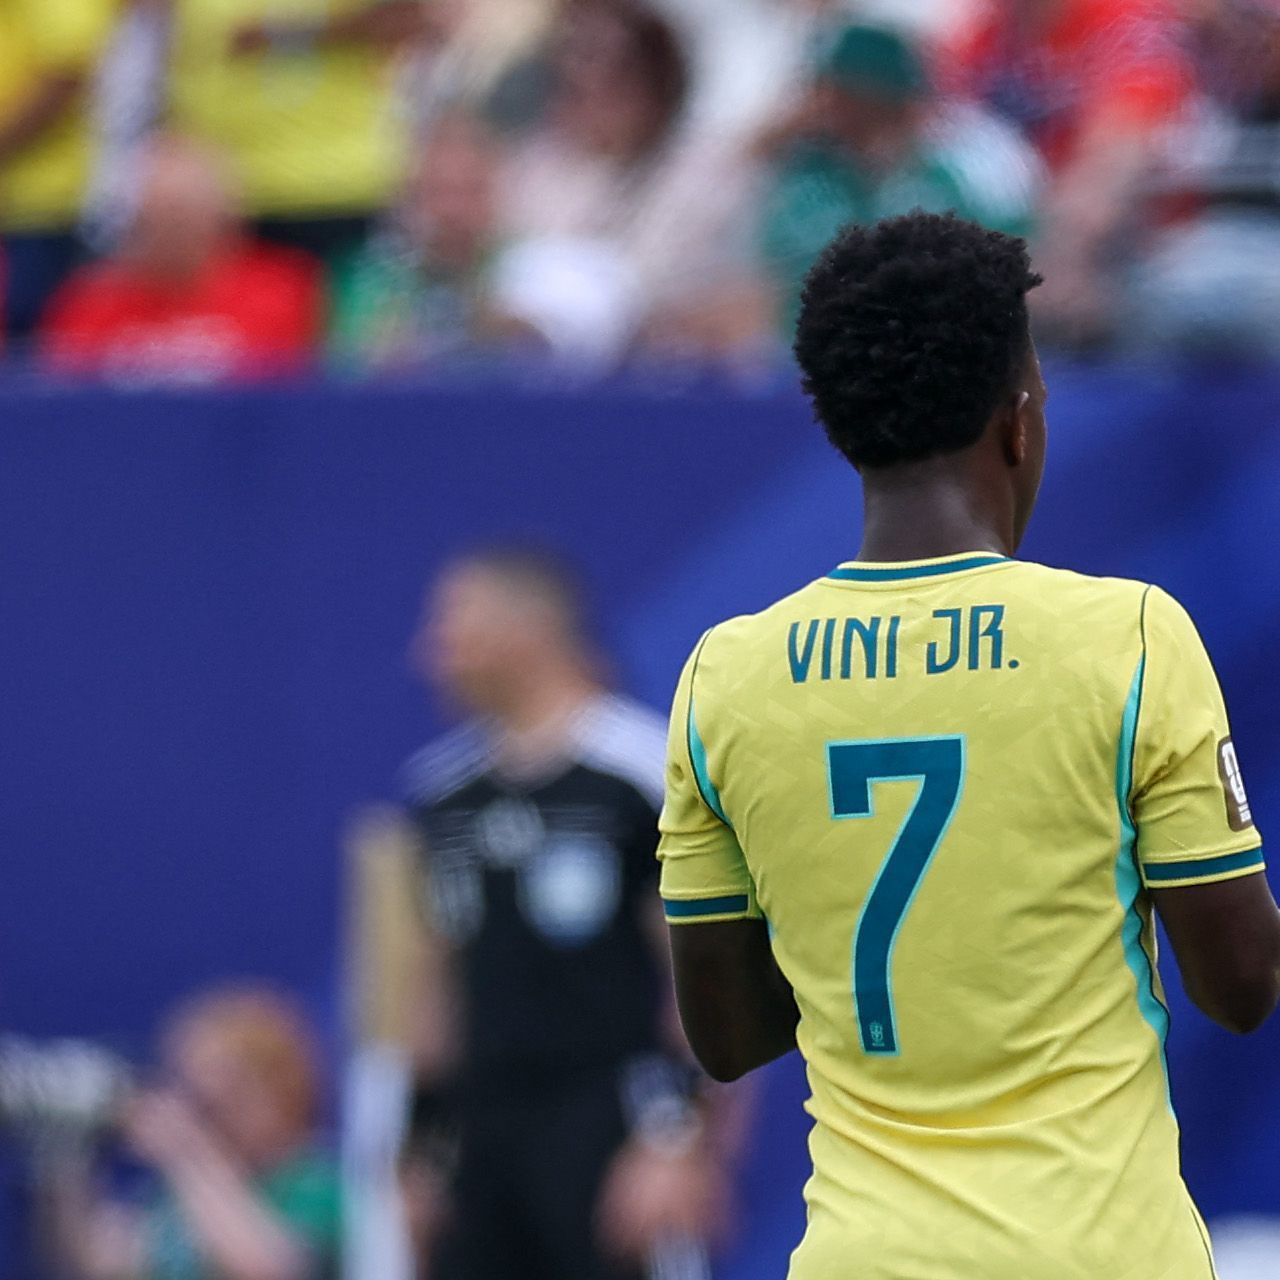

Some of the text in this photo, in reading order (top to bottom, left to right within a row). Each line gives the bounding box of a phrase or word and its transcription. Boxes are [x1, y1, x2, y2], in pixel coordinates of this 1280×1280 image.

[787, 604, 1020, 684] VINI JR.
[826, 733, 966, 1056] 7
